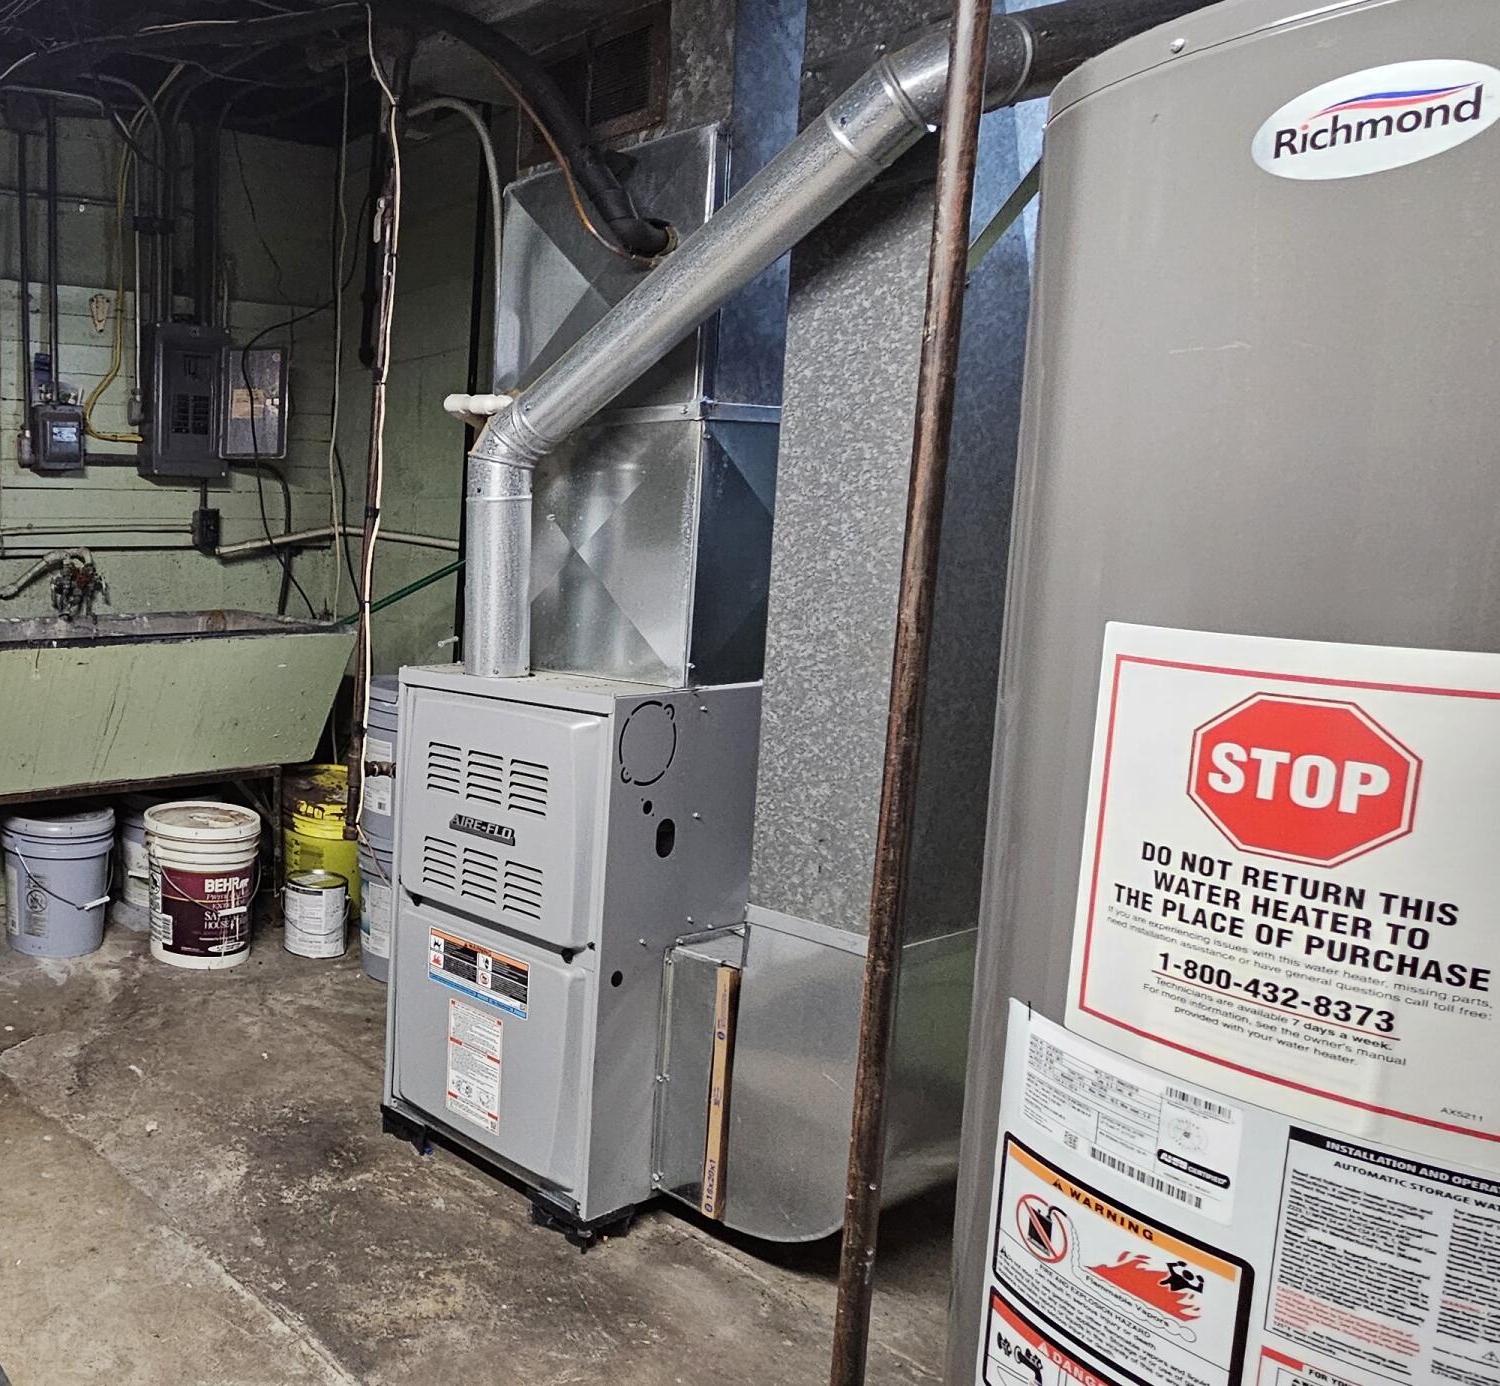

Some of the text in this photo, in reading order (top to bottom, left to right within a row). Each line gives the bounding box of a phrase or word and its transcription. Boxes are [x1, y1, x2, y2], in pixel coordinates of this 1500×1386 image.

[1273, 83, 1483, 159] Richmond
[1207, 742, 1390, 814] STOP
[451, 814, 512, 840] AIRE-FLO
[204, 877, 240, 893] BEHR
[1141, 841, 1459, 926] DO NOT RETURN THIS
[1154, 870, 1429, 950] WATER HEATER TO
[1107, 916, 1127, 928] need
[1130, 923, 1177, 944] installation
[1180, 941, 1235, 962] assistance
[1254, 959, 1282, 973] have
[1285, 970, 1332, 987] general
[1336, 981, 1400, 1002] questions
[1405, 997, 1429, 1008] call
[1434, 1001, 1455, 1013] toll
[1459, 1007, 1492, 1020] free:
[1114, 883, 1491, 992] THE PLACE OF PURCHASE
[1116, 908, 1130, 919] you
[1132, 915, 1147, 924] are
[1149, 919, 1210, 944] experiencing
[1213, 939, 1248, 954] issues
[1252, 949, 1276, 961] with
[1279, 955, 1301, 968] this
[1305, 962, 1339, 976] water
[1394, 982, 1448, 999] missing
[1142, 983, 1160, 994] For
[1161, 991, 1186, 1004] more
[1256, 1022, 1277, 1032] see
[1281, 1028, 1300, 1038] the
[1304, 1034, 1352, 1053] owner's
[1357, 1048, 1407, 1066] manual
[1155, 976, 1213, 1002] Technicians
[1216, 998, 1234, 1008] are
[1237, 1003, 1288, 1023] available
[1303, 1022, 1335, 1037] days
[1352, 1035, 1393, 1051] week.
[1159, 952, 1395, 1033] 1-800-432-8373
[1174, 1005, 1357, 1066] provided with your water heater.
[1325, 1140, 1417, 1174] INSTALLATION
[1419, 1168, 1450, 1181] AND
[1333, 1160, 1408, 1188] AUTOMATIC
[1409, 1182, 1470, 1205] STORAGE
[1070, 1187, 1154, 1242] WARNING
[1086, 1275, 1170, 1327] Flammable Vapors
[1113, 1314, 1151, 1338] HAZARD
[1052, 1351, 1108, 1386] DANG
[1309, 1369, 1328, 1382] FOR
